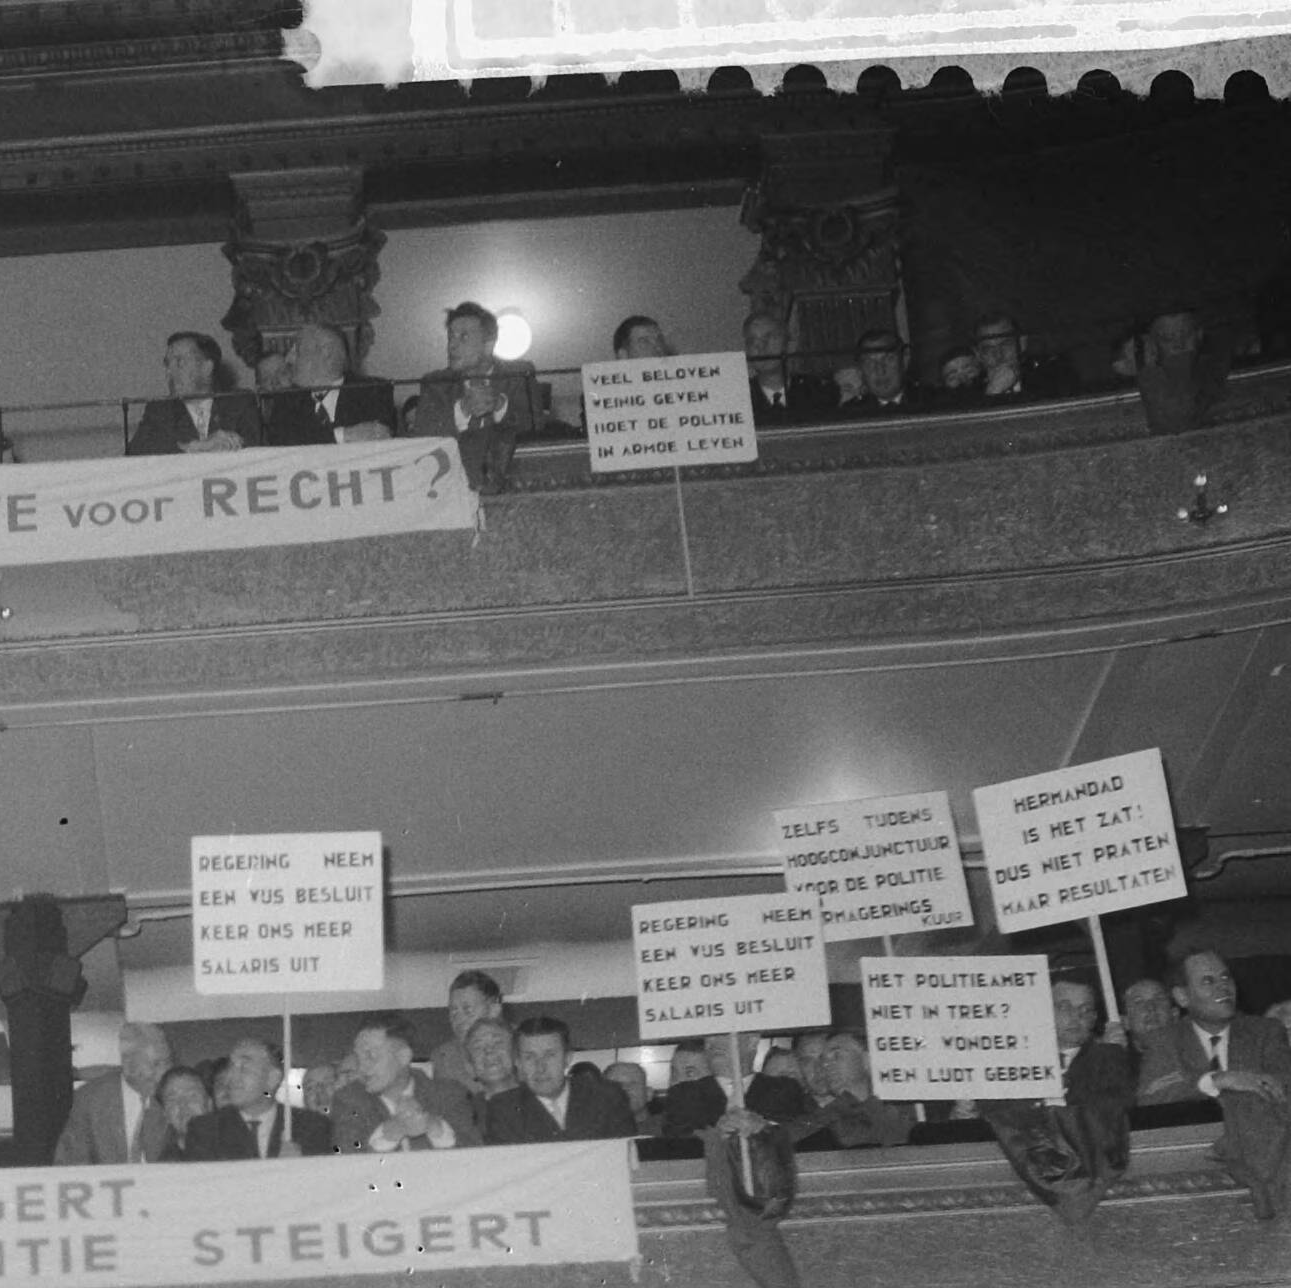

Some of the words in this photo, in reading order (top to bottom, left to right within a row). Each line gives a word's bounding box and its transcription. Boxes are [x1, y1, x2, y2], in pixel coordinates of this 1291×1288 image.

[591, 374, 632, 385] VEEL
[642, 365, 721, 382] BELOVEN
[654, 391, 709, 405] GEVEN
[648, 418, 668, 429] DE
[679, 412, 745, 427] POLITIE
[598, 446, 613, 458] IN
[622, 441, 677, 456] ARMOE
[687, 437, 744, 451] LEVEN
[62, 497, 174, 529] voor
[201, 446, 452, 518] RECHT?
[1013, 775, 1125, 814] HERMANDAD
[781, 819, 839, 839] ZELFS
[1022, 827, 1040, 845] IS
[1050, 816, 1085, 839] HET
[199, 853, 291, 871] REGERING
[787, 835, 950, 869] HOOGCONJUNCTUUR
[995, 863, 1031, 885] DUS
[1042, 852, 1082, 874] NIET
[1092, 832, 1171, 863] PRATEN
[845, 875, 868, 891] DE
[875, 866, 945, 887] POLITIE
[200, 890, 236, 906] EEN
[295, 886, 373, 904] BESLUIT
[1001, 893, 1050, 915] MAAR
[1058, 865, 1177, 904] RESULTATEN
[200, 924, 248, 940] KEER
[258, 923, 293, 939] ONS
[304, 921, 353, 937] MEER
[639, 913, 729, 934] REGERING
[641, 949, 676, 963] EEN
[737, 935, 814, 955] BESLUIT
[201, 957, 280, 975] SALARIS
[290, 956, 321, 972] UIT
[643, 975, 691, 992] KEER
[700, 972, 736, 988] ONS
[747, 967, 795, 984] MEER
[868, 973, 905, 988] HET
[915, 972, 1038, 988] POLITIEAMBT
[645, 1003, 724, 1022] SALARIS
[735, 999, 764, 1015] UIT
[871, 1005, 913, 1019] NIET
[922, 1006, 939, 1019] IN
[879, 1068, 917, 1083] MEN
[984, 1066, 1055, 1082] GEBREK
[192, 1209, 552, 1266] STEIGERT
